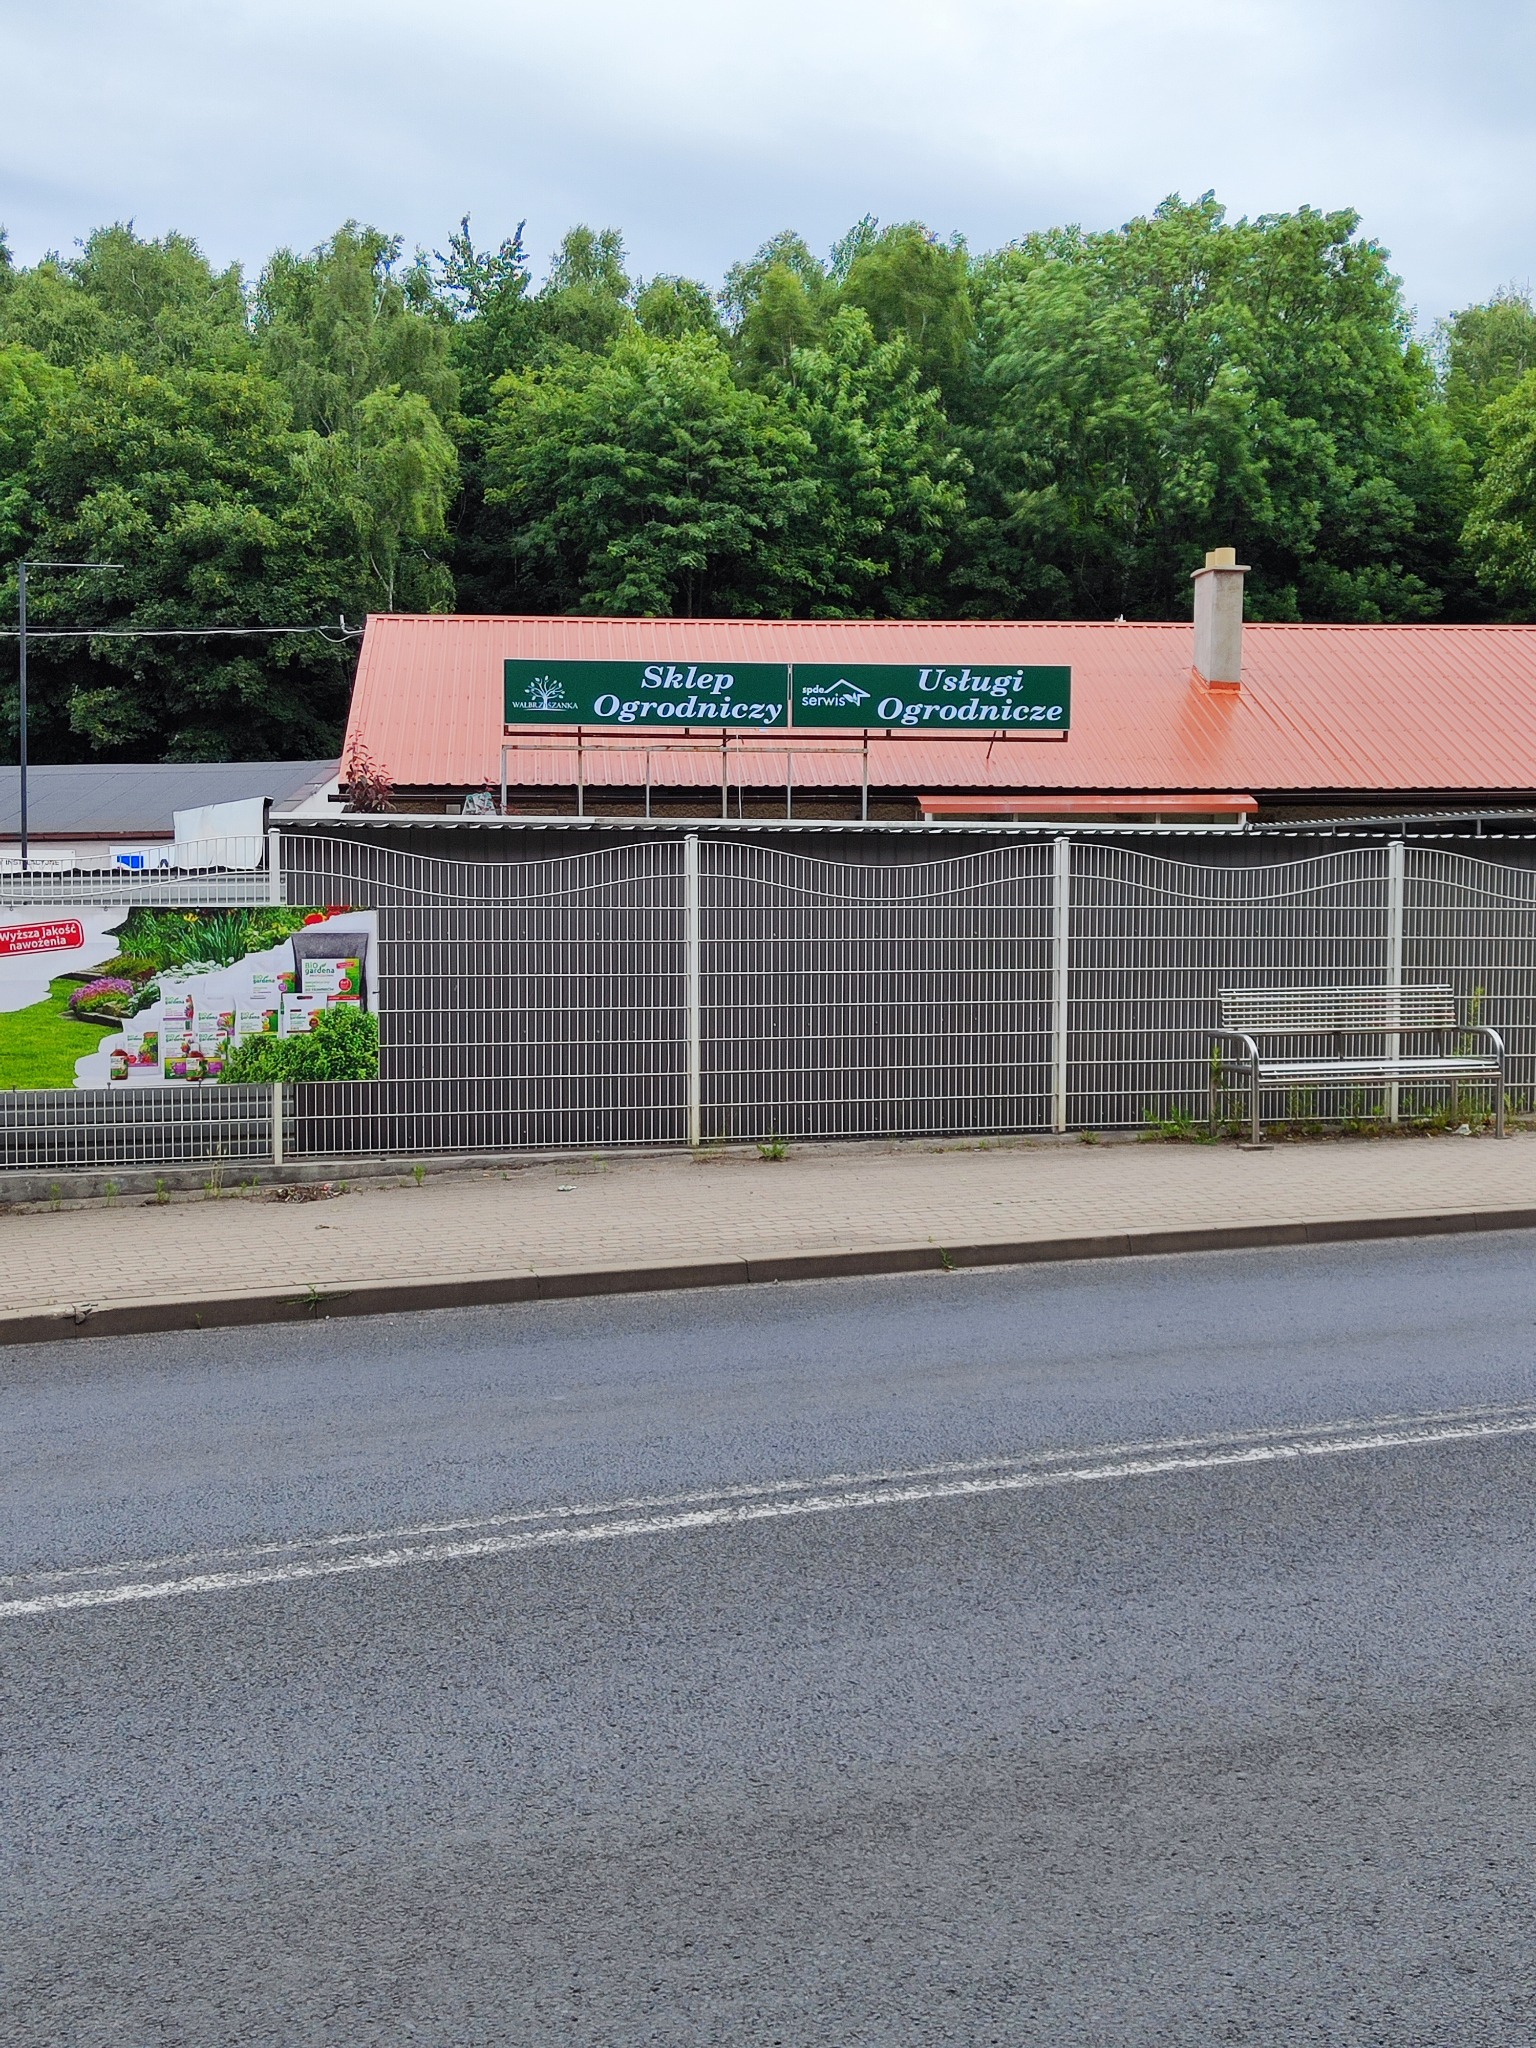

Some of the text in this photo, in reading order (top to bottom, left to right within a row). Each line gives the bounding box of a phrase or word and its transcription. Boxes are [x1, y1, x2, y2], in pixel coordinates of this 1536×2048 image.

[641, 665, 734, 695] Sklep
[802, 684, 825, 695] spde
[918, 668, 1024, 697] Usługi
[593, 694, 783, 724] Ogrodniczy
[802, 695, 845, 706] serwis
[877, 696, 1063, 726] Ogrodnicze
[0, 923, 77, 942] Wyższa jakość
[9, 936, 67, 951] nawożenia
[305, 966, 335, 976] gardena
